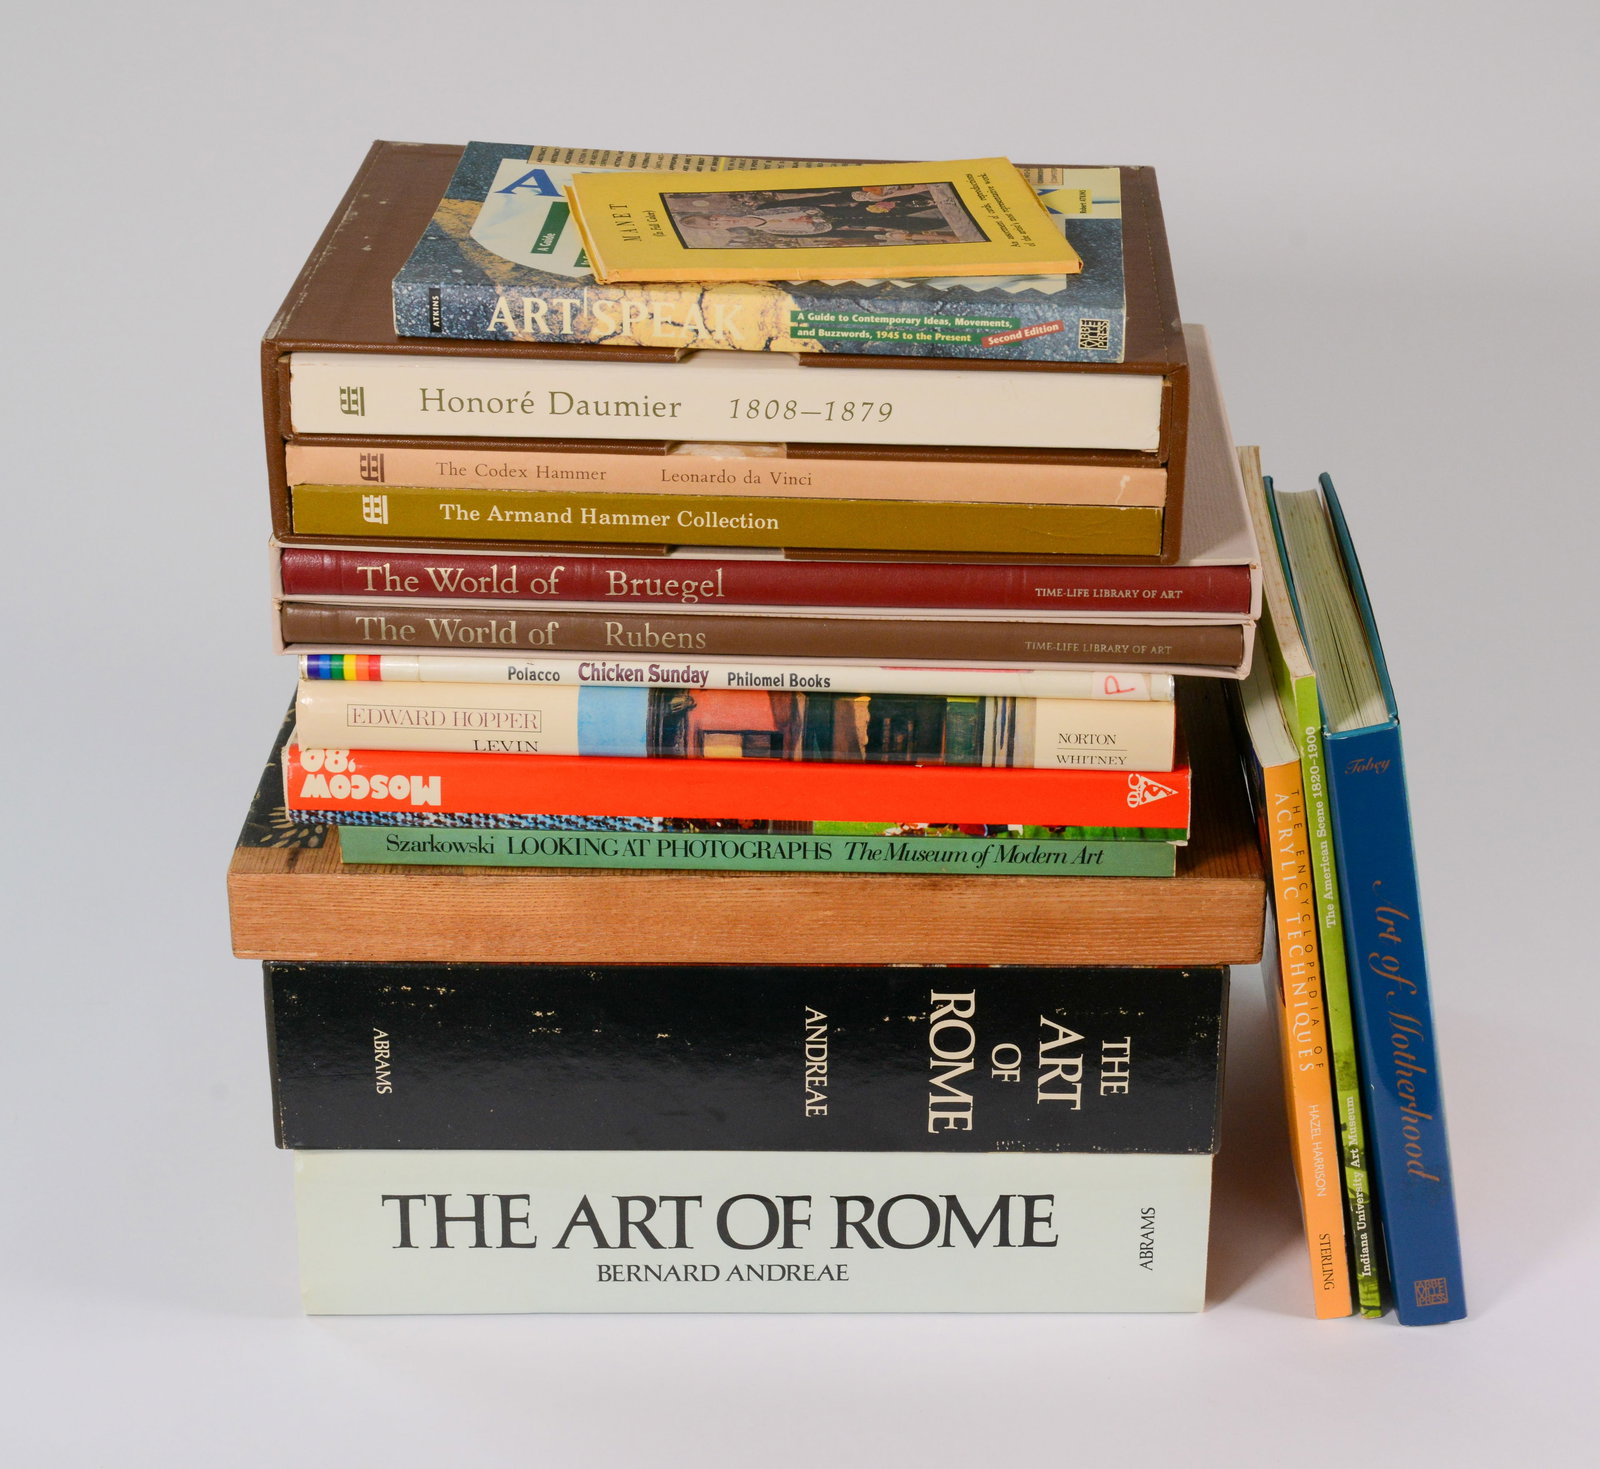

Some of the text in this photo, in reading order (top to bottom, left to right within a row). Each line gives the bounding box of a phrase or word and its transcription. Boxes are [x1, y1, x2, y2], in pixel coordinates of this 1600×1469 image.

[608, 203, 642, 242] MANET
[431, 294, 441, 329] ATKINS
[808, 313, 836, 322] Guide
[838, 314, 849, 322] to
[852, 314, 921, 328] Contemporary
[924, 317, 951, 327] Ideas,
[954, 317, 1013, 329] Movements,
[797, 328, 971, 342] and Buzzwords, 1945 to the Present
[987, 323, 1059, 346] Second Edition
[419, 387, 535, 415] Honoré
[549, 391, 682, 419] Daumier
[435, 461, 813, 486] The Codex Hammer Leonardo da Vinci
[439, 504, 779, 531] The Armand Hammer Collection
[356, 564, 1183, 603] The World of Bruegel TIME-LIFE LIBRARY OF ART
[355, 616, 1173, 656] The World of Rubens TIME-LIFE LIBRARY OF ART
[508, 662, 831, 689] Polacco Chicken Sunday Philomel Books
[351, 706, 539, 730] EDWARD HOPPER
[473, 739, 539, 752] LEVIN
[1058, 732, 1117, 745] NORTON
[1055, 754, 1128, 766] WHITNEY
[1344, 757, 1392, 775] Tobey
[1315, 800, 1328, 838] Scene
[386, 834, 1104, 868] Szarkowski LOOKING AT PHOTOGRAPHS The Museum of Modern Art
[1319, 840, 1335, 901] American
[1274, 793, 1315, 1072] ACRYLIC TECHNIQUES
[1290, 789, 1324, 1069] THE ENCYCLOPEDIA OF
[1325, 903, 1336, 929] The
[1367, 880, 1441, 1184] Art of Motherhood
[372, 1027, 393, 1095] ABRAMS
[804, 1005, 828, 1118] ANDREAE
[927, 988, 977, 1134] ROME
[992, 1043, 1022, 1084] OF
[1037, 1014, 1085, 1111] ART
[1099, 1036, 1131, 1097] THE
[1308, 1104, 1328, 1198] HAZEL HARRISON
[1345, 1096, 1373, 1277] Indiana University Art Museum
[381, 1193, 1059, 1251] THE ART OF ROME
[1138, 1205, 1156, 1271] ABRAMS
[596, 1263, 849, 1283] BERNARD ANDREAE
[1318, 1232, 1335, 1291] STERLING
